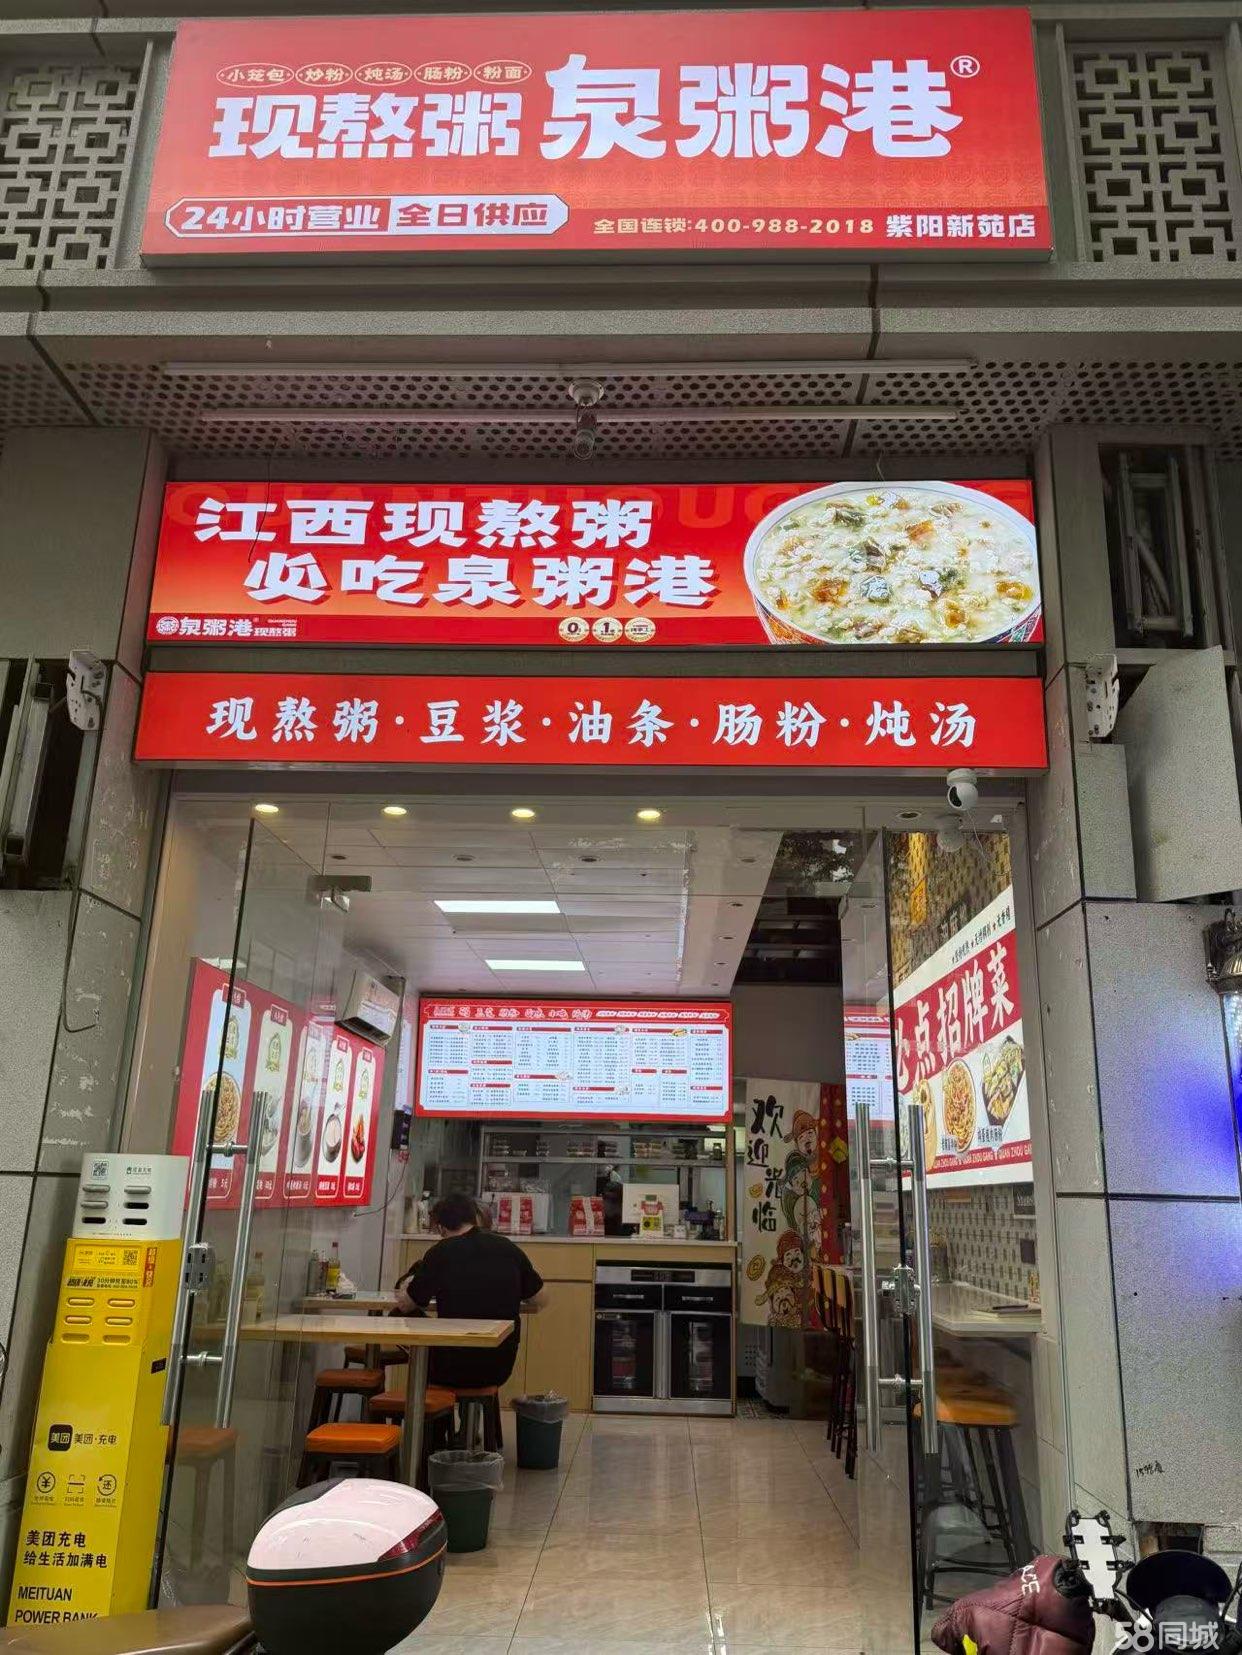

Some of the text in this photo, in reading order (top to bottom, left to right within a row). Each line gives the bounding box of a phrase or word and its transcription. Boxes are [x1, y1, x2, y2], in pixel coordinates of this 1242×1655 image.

[304, 67, 345, 82] 炒粉
[363, 66, 404, 81] 炖汤
[423, 65, 464, 81] 肠粉
[483, 65, 524, 80] 粉面
[539, 53, 964, 160] 泉粥港
[208, 90, 522, 160] 现熬粥
[180, 202, 549, 232] 24小时营业 全日供应
[886, 213, 1036, 239] 紫阳新苑店
[194, 496, 653, 548] 江西现熬粥
[244, 552, 718, 606] 必吃泉粥港
[179, 616, 254, 637] 泉粥港
[746, 1094, 785, 1233] 欢迎光临
[26, 1530, 86, 1547] 美团充电
[23, 1551, 108, 1569] 给生活加满电
[18, 1586, 73, 1602] MEITUAN
[15, 1609, 61, 1624] POWER
